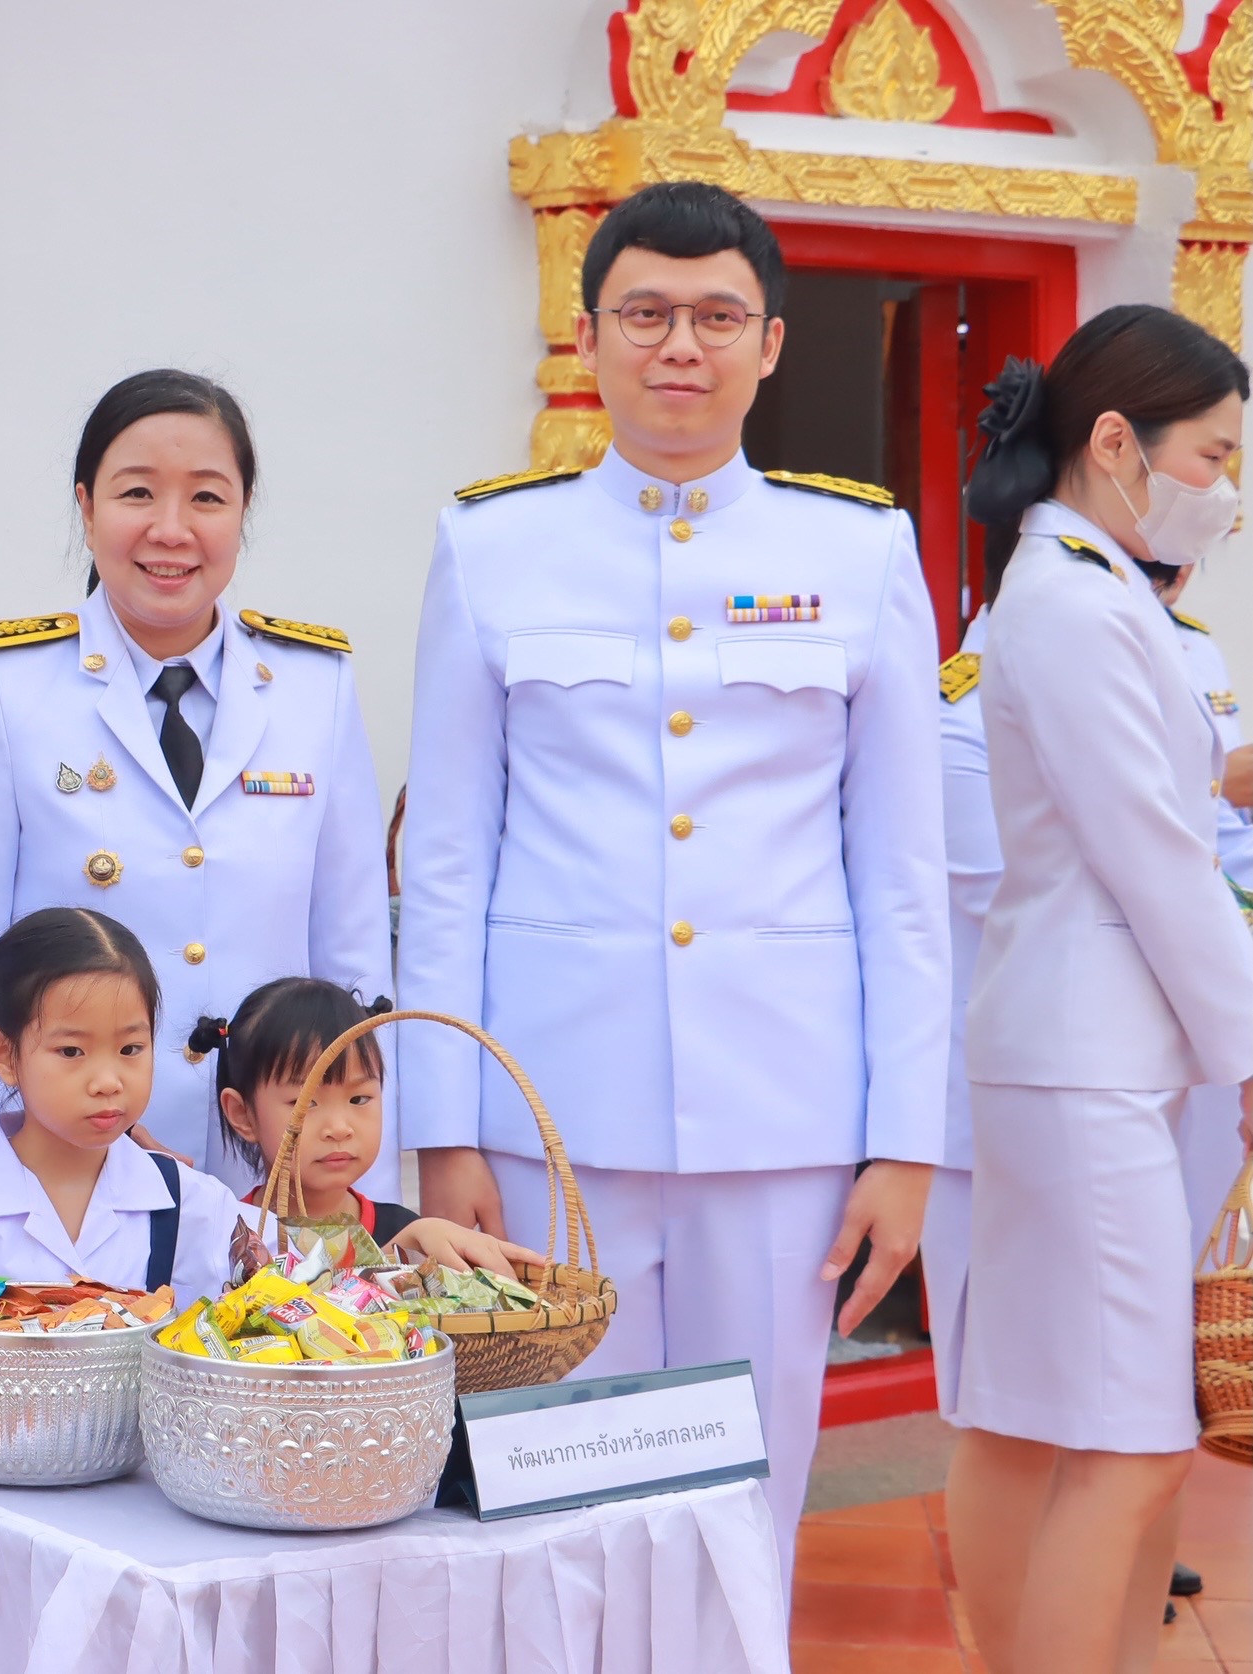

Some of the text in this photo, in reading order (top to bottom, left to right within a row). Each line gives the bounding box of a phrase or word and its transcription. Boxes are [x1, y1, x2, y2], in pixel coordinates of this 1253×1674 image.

[507, 1420, 727, 1471] พัฒนาการจังหวัดสกลนคร
